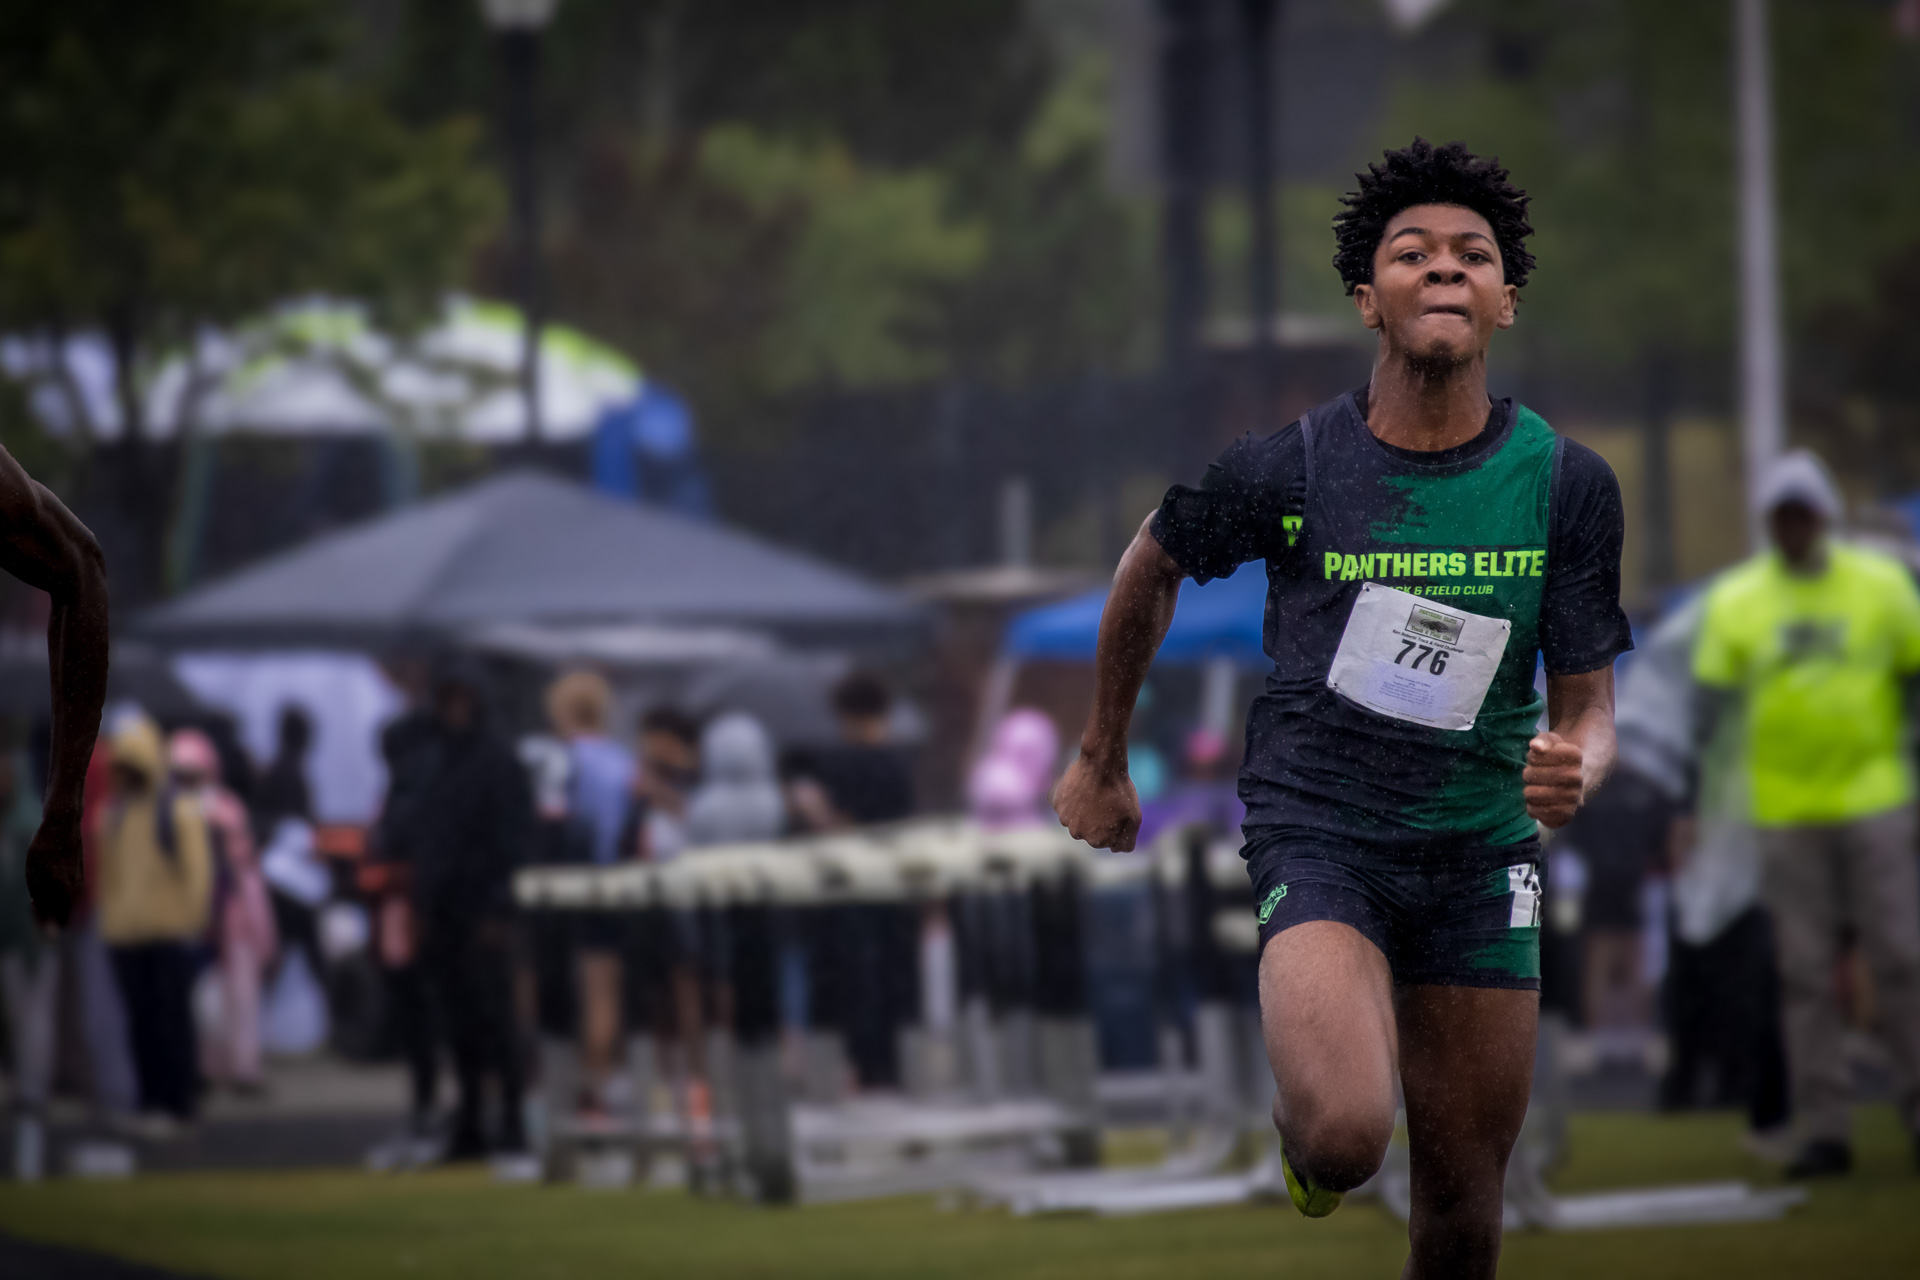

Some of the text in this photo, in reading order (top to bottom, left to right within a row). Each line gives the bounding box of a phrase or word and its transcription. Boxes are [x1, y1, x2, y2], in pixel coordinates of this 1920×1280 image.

[1324, 550, 1545, 581] PANTHERS ELITE
[1413, 586, 1423, 596] &
[1425, 585, 1460, 596] FIELD
[1463, 585, 1494, 595] CLUB
[1394, 639, 1449, 675] 776
